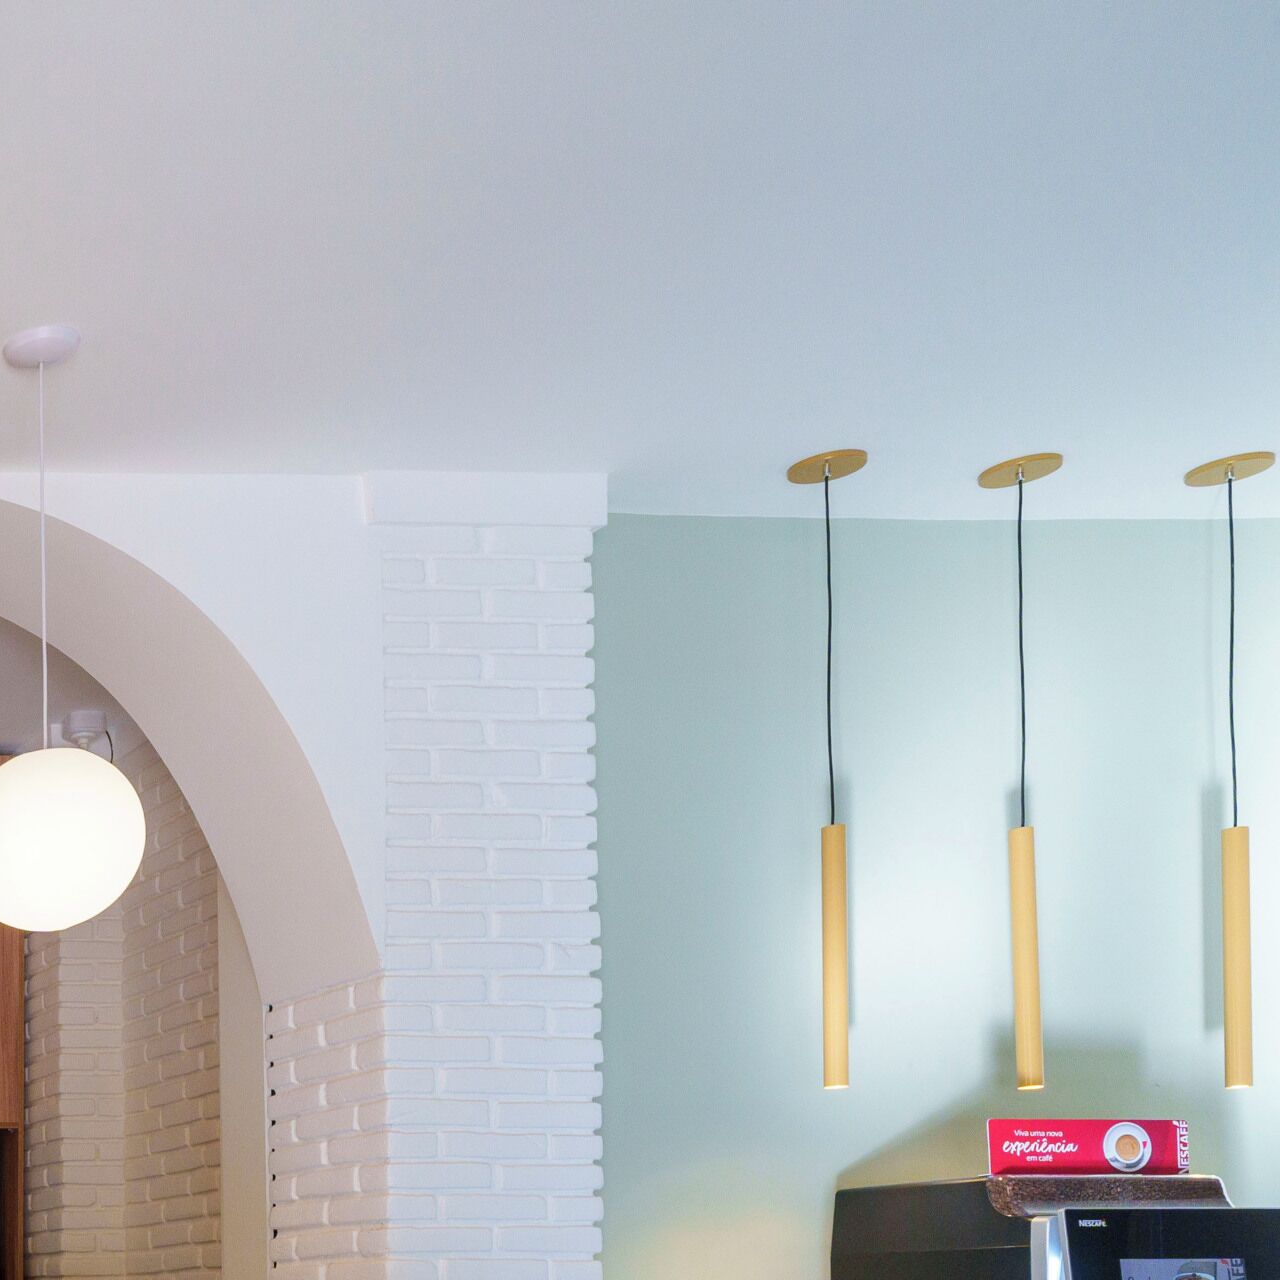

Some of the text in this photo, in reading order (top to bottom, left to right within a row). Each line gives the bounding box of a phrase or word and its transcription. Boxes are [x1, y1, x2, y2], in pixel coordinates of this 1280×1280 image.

[1013, 1129, 1029, 1137] Viva
[1002, 1138, 1079, 1157] experiência
[1038, 1154, 1053, 1162] café
